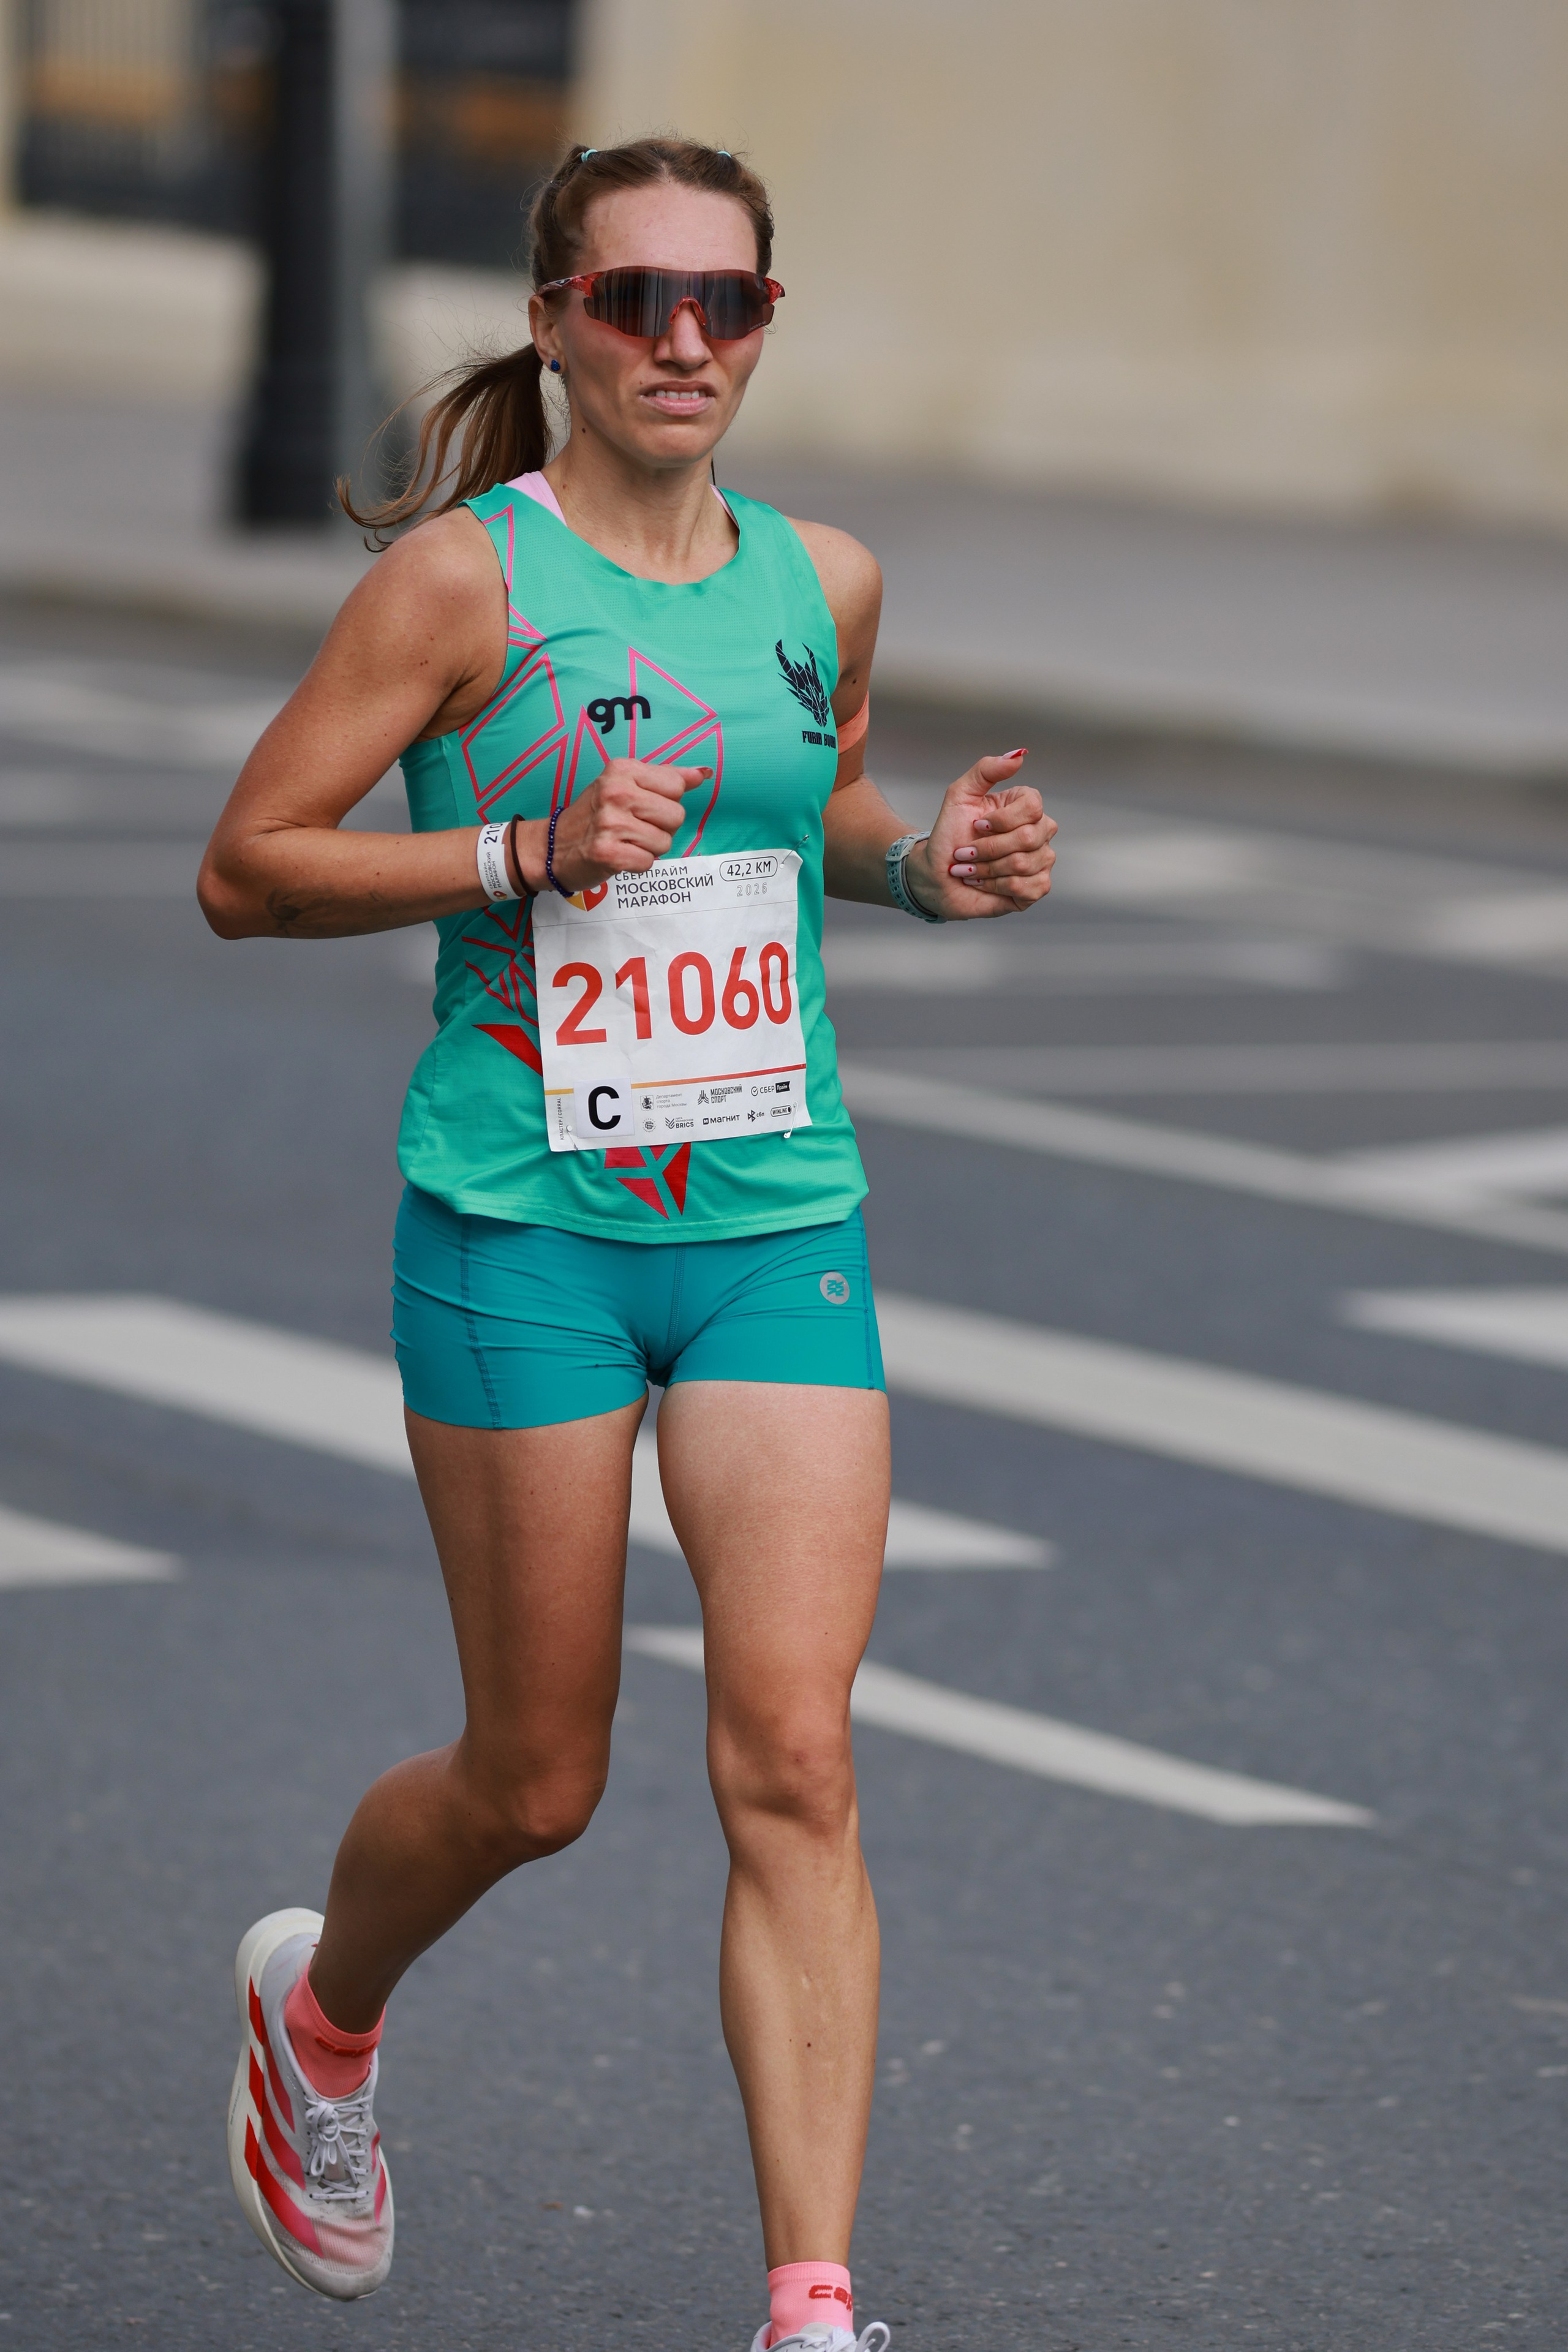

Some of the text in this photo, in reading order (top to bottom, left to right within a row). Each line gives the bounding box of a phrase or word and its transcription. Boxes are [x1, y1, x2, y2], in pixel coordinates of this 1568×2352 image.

[727, 864, 752, 876] 42,2
[616, 873, 714, 895] МОСКОВСКИЙ
[736, 882, 767, 897] 2026
[617, 891, 692, 909] МАРАФОН
[552, 941, 792, 1046] 21060
[710, 1084, 742, 1096] МОСКОВСКИЙ
[760, 1085, 775, 1094] СБЕР
[711, 1095, 727, 1104] СПОРТ
[710, 1114, 740, 1123] магнит
